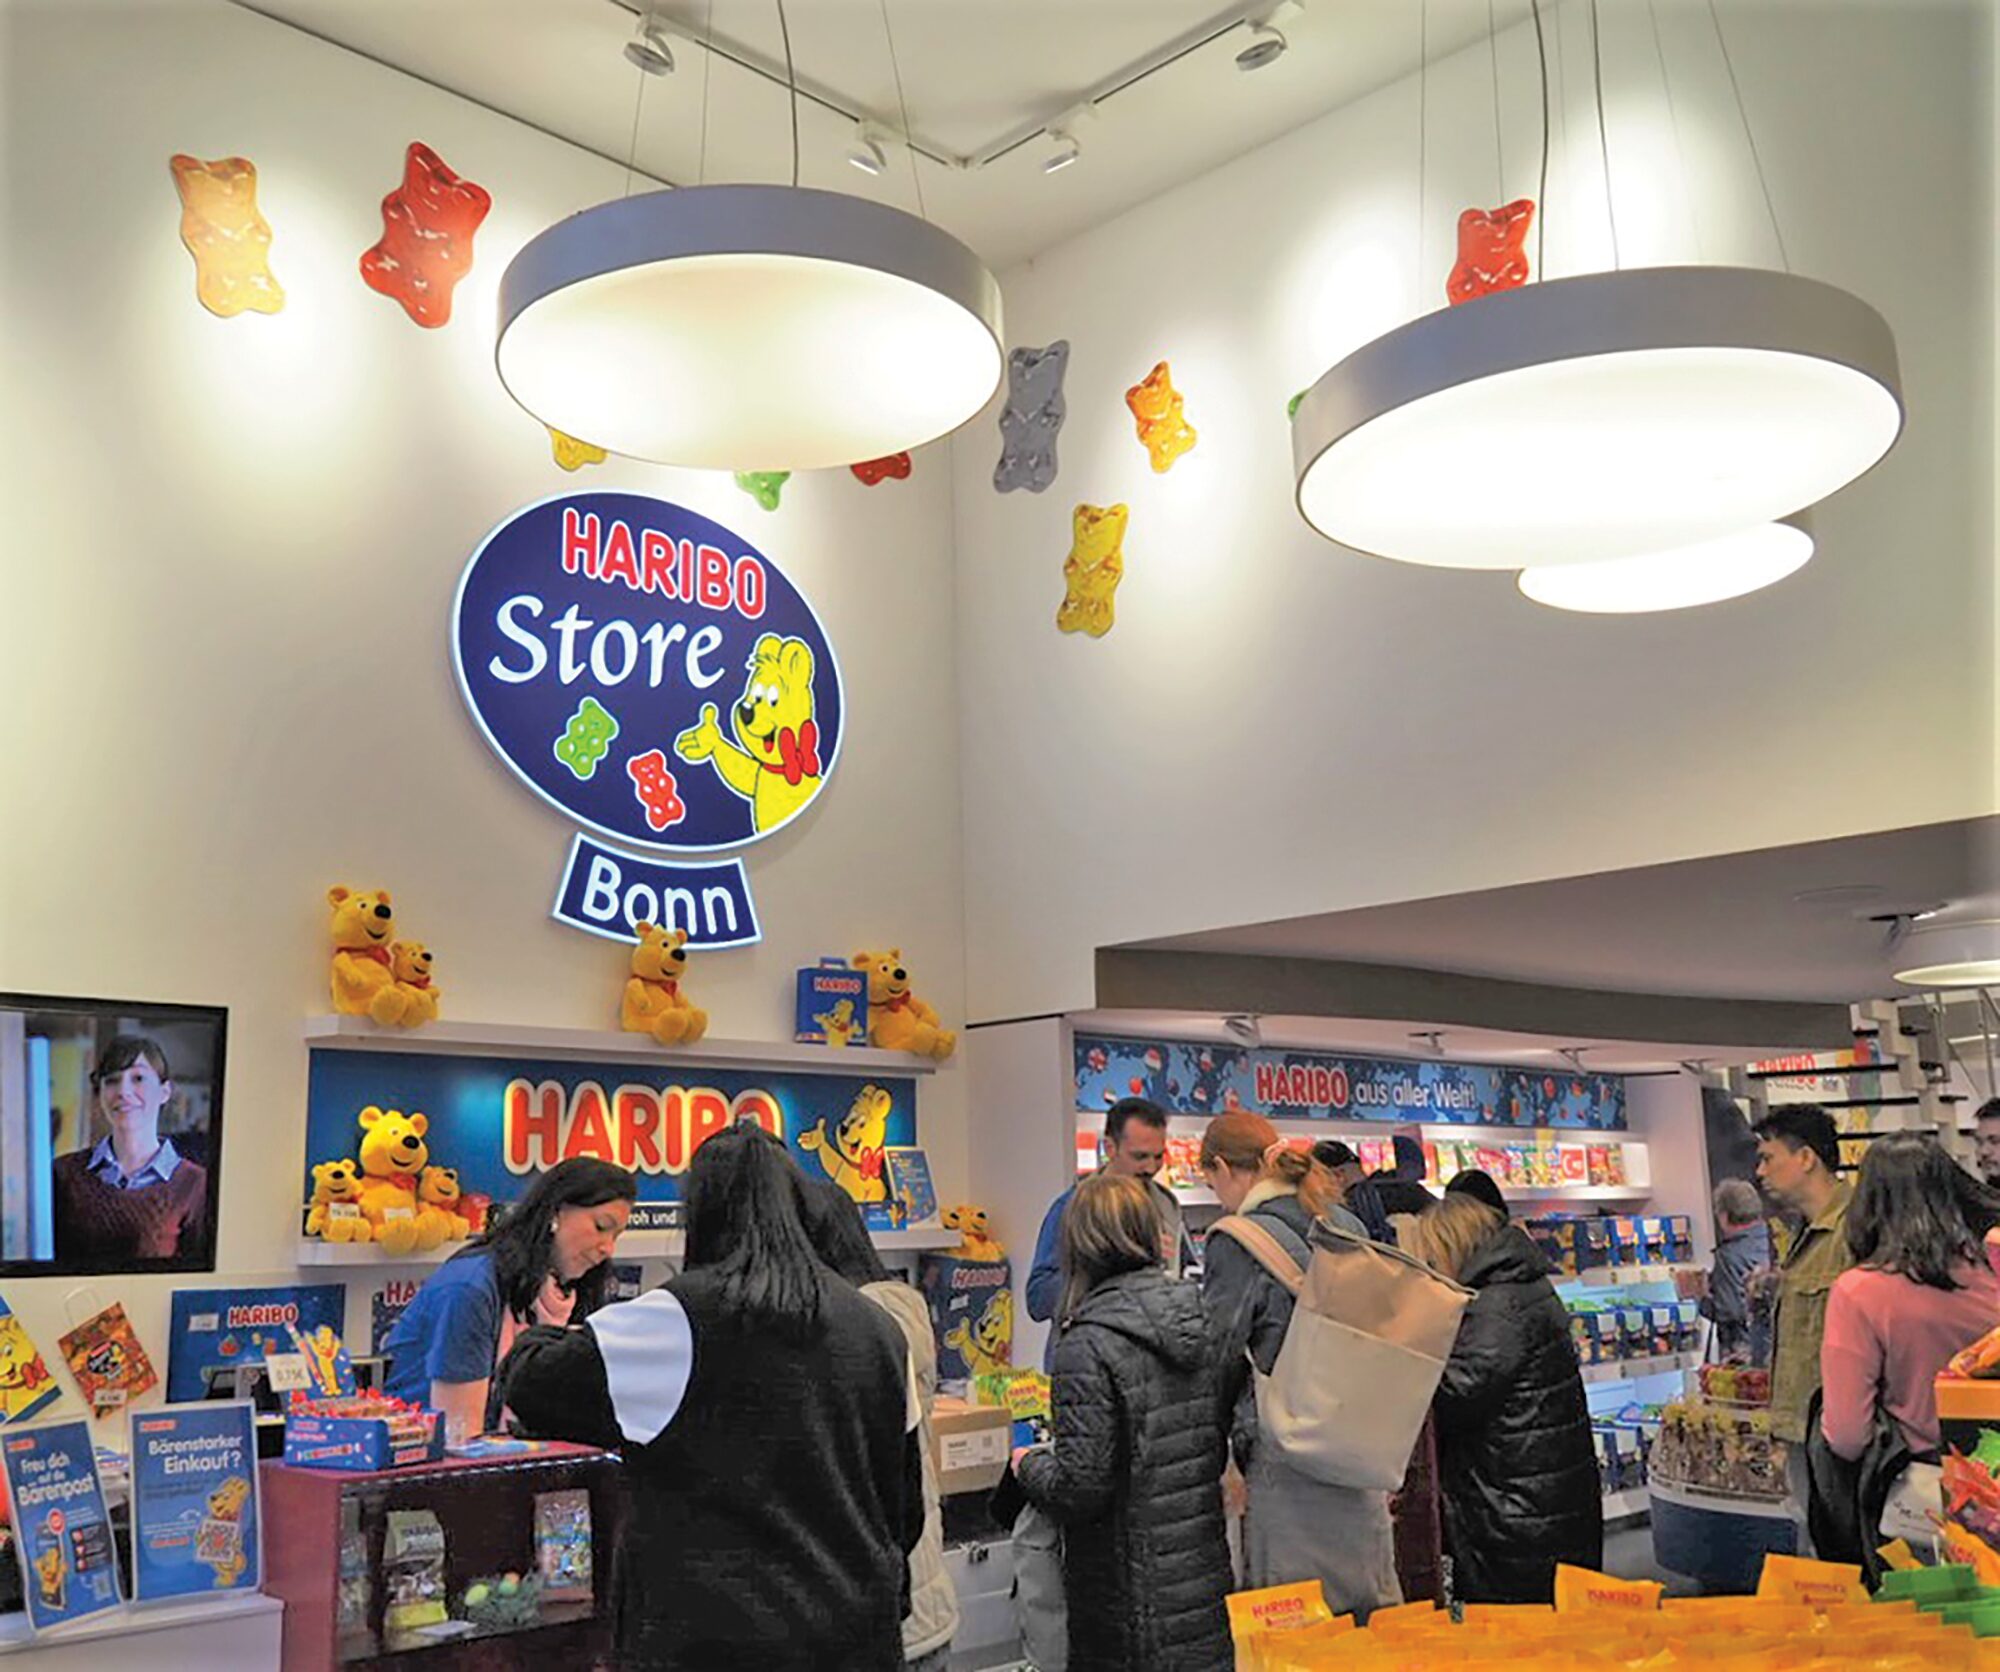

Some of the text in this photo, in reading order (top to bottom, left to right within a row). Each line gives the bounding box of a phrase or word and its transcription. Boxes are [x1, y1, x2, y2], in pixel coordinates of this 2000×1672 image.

[562, 508, 766, 618] HARIBO
[489, 595, 725, 688] Store
[582, 855, 737, 936] Bonn
[1255, 1062, 1477, 1109] HARIBO aus aller Welt!
[627, 1210, 677, 1224] roh und
[228, 1302, 299, 1328] HARIBO
[148, 1434, 242, 1456] Bärenstarker
[164, 1450, 242, 1475] Einkauf?
[18, 1472, 95, 1506] Bärenpost
